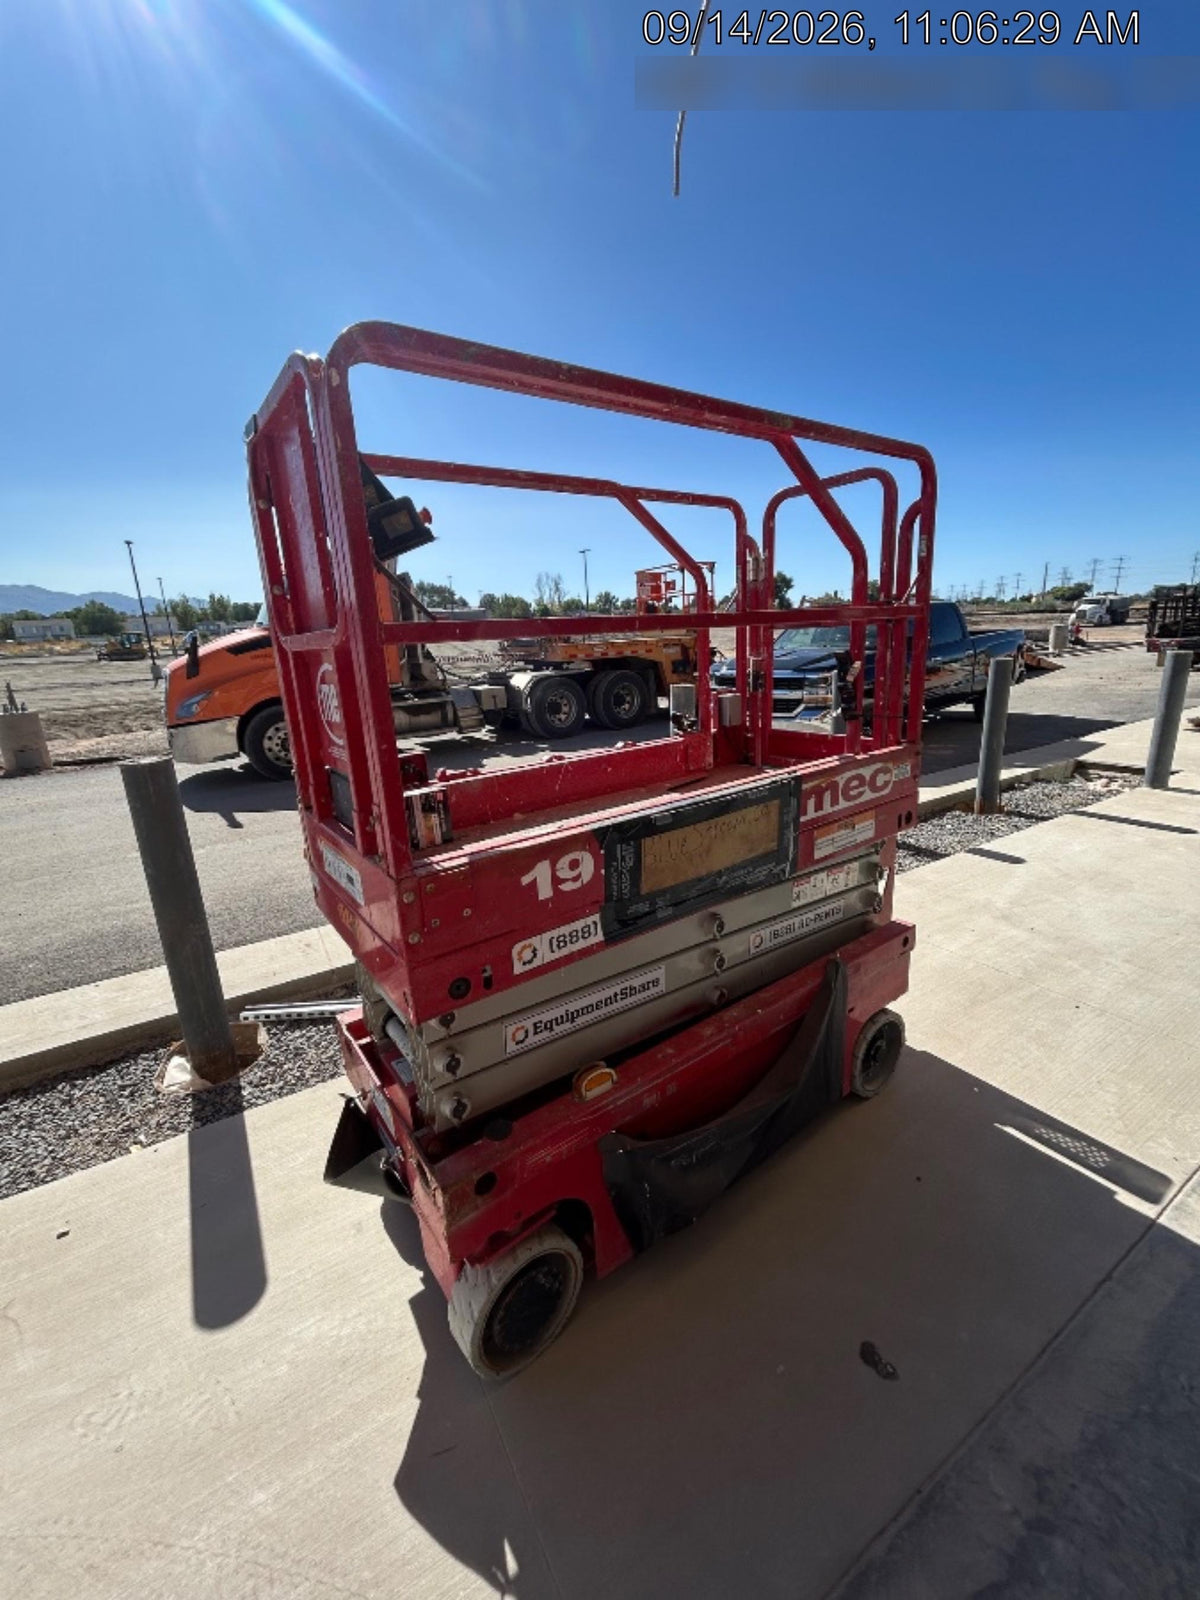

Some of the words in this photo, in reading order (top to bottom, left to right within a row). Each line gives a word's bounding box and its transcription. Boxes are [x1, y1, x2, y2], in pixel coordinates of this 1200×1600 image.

[520, 850, 595, 901] 19
[549, 920, 598, 953] (888)
[532, 976, 661, 1037] EquipmentShare
